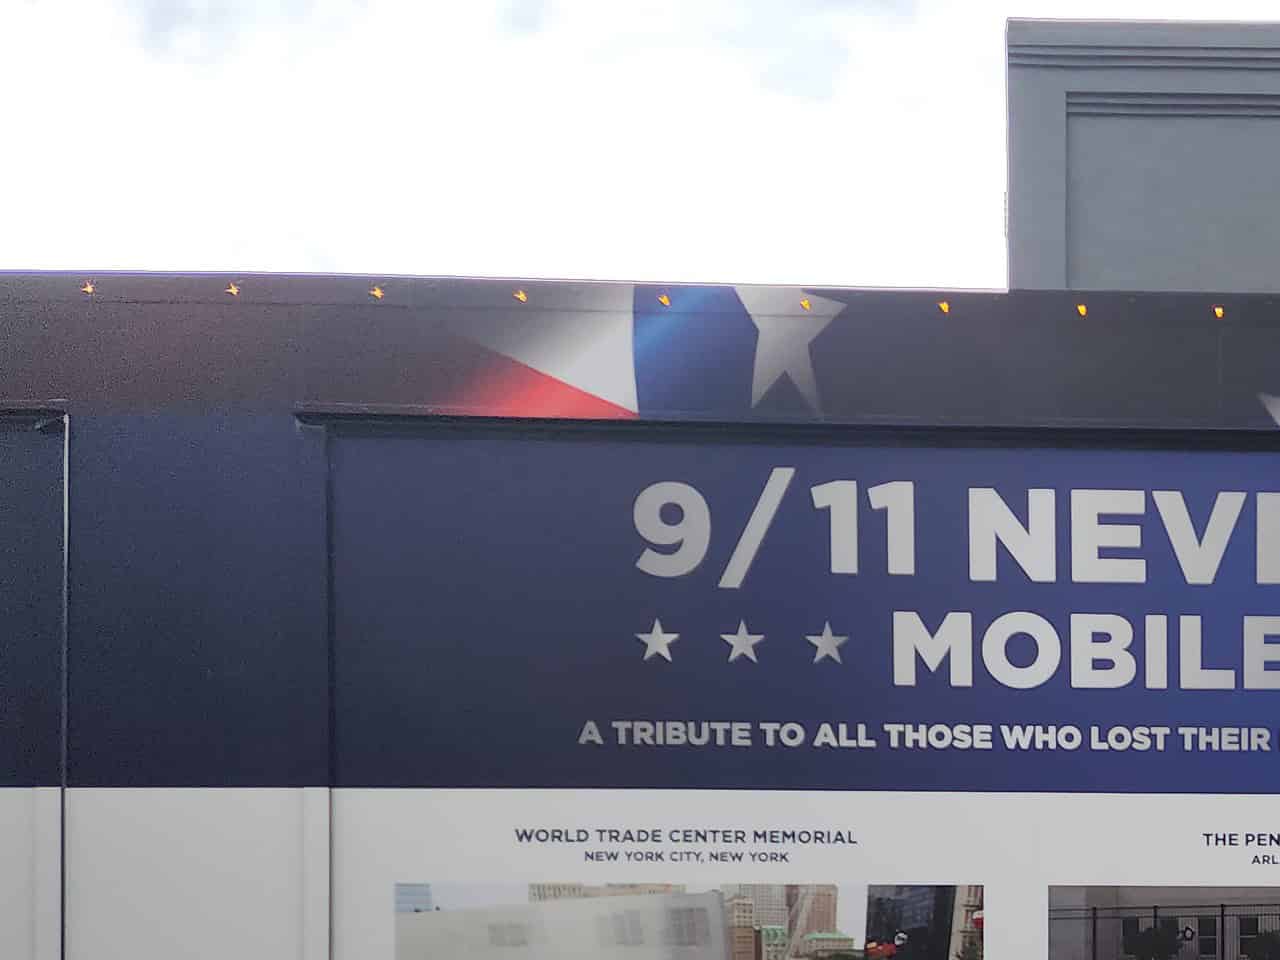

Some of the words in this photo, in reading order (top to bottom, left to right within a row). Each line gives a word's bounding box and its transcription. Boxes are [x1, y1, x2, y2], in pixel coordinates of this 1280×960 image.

[633, 466, 916, 589] 9/11
[578, 720, 604, 745] A
[611, 720, 753, 747] TRIBUTE
[759, 722, 806, 748] TO
[812, 722, 878, 749] ALL
[883, 722, 993, 751] THOSE
[999, 724, 1083, 752] WHO
[1088, 725, 1171, 752] LOST
[1177, 726, 1271, 752] THEIR
[514, 828, 590, 843] WORLD
[595, 828, 663, 844] TRADE
[668, 829, 747, 844] CENTER
[752, 830, 859, 845] MEMORIAL
[1201, 832, 1240, 847] THE
[584, 850, 620, 862] NEW
[624, 850, 665, 862] YORK
[669, 850, 705, 864] CITY,
[708, 851, 745, 863] NEW
[748, 851, 790, 863] YORK
